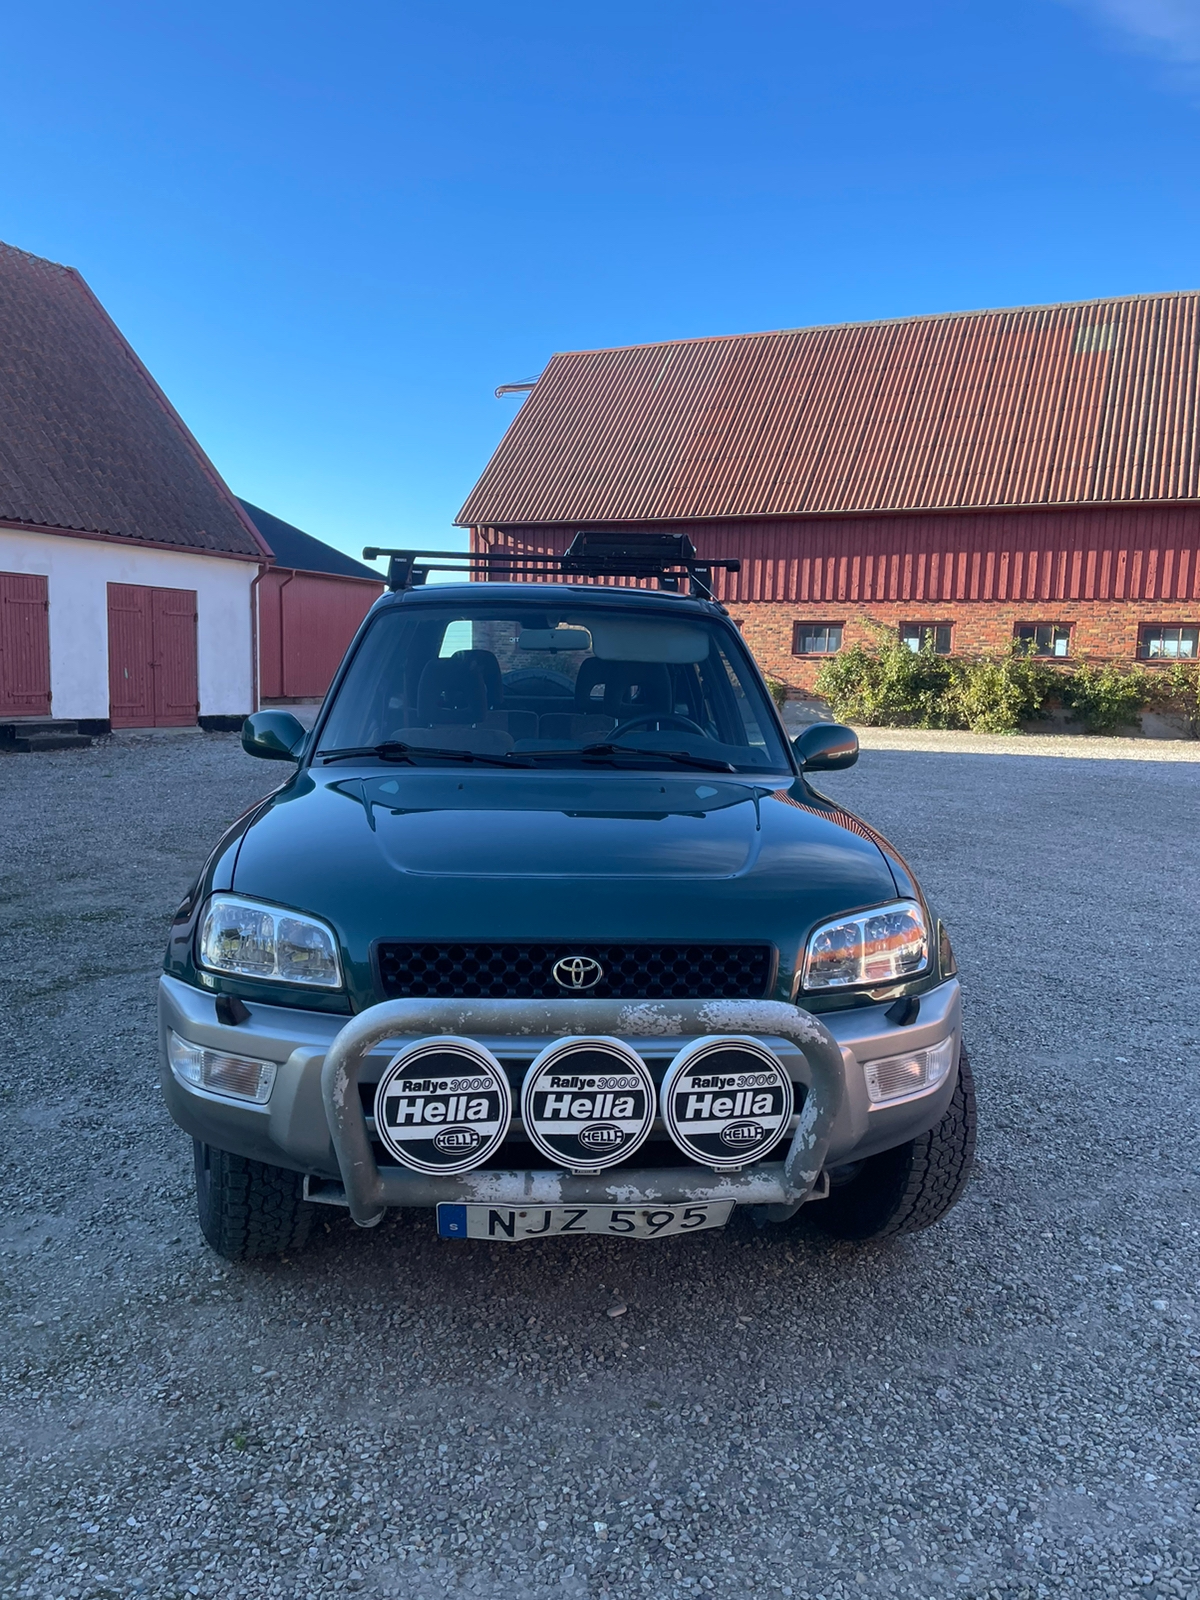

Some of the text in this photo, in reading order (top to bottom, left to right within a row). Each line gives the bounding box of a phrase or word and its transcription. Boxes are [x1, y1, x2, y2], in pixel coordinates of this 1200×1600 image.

[402, 1078, 494, 1094] Rallye 3000
[550, 1076, 640, 1091] Rallye 3000
[691, 1073, 778, 1090] Rallye 3000
[396, 1096, 490, 1123] Hella
[543, 1094, 635, 1119] Hella
[685, 1091, 774, 1119] Hella
[437, 1132, 480, 1146] HELLA
[582, 1130, 624, 1143] HELLA
[724, 1126, 764, 1139] HELLA
[449, 1223, 459, 1231] S
[488, 1205, 709, 1238] NJZ 595
